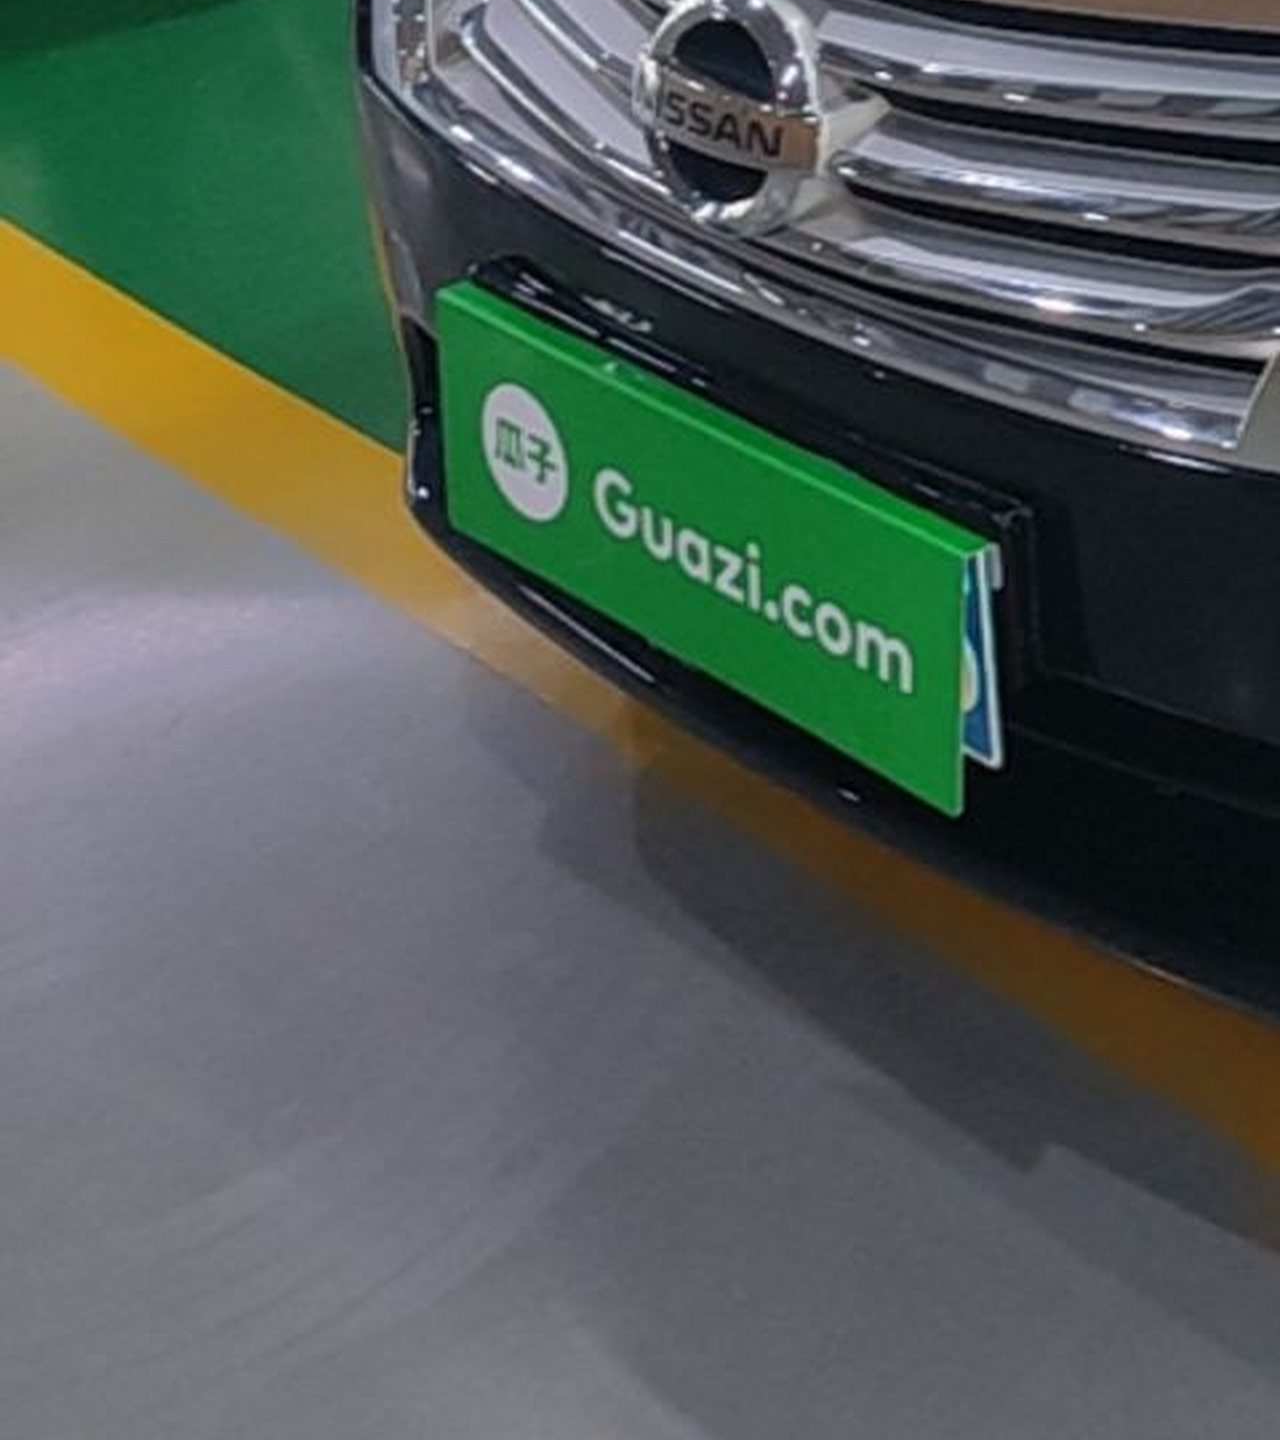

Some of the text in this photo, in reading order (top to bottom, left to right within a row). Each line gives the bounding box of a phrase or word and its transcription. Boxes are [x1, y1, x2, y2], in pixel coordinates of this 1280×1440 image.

[655, 86, 783, 158] ISSAN
[494, 416, 914, 695] 瓜子 Guazi.com
